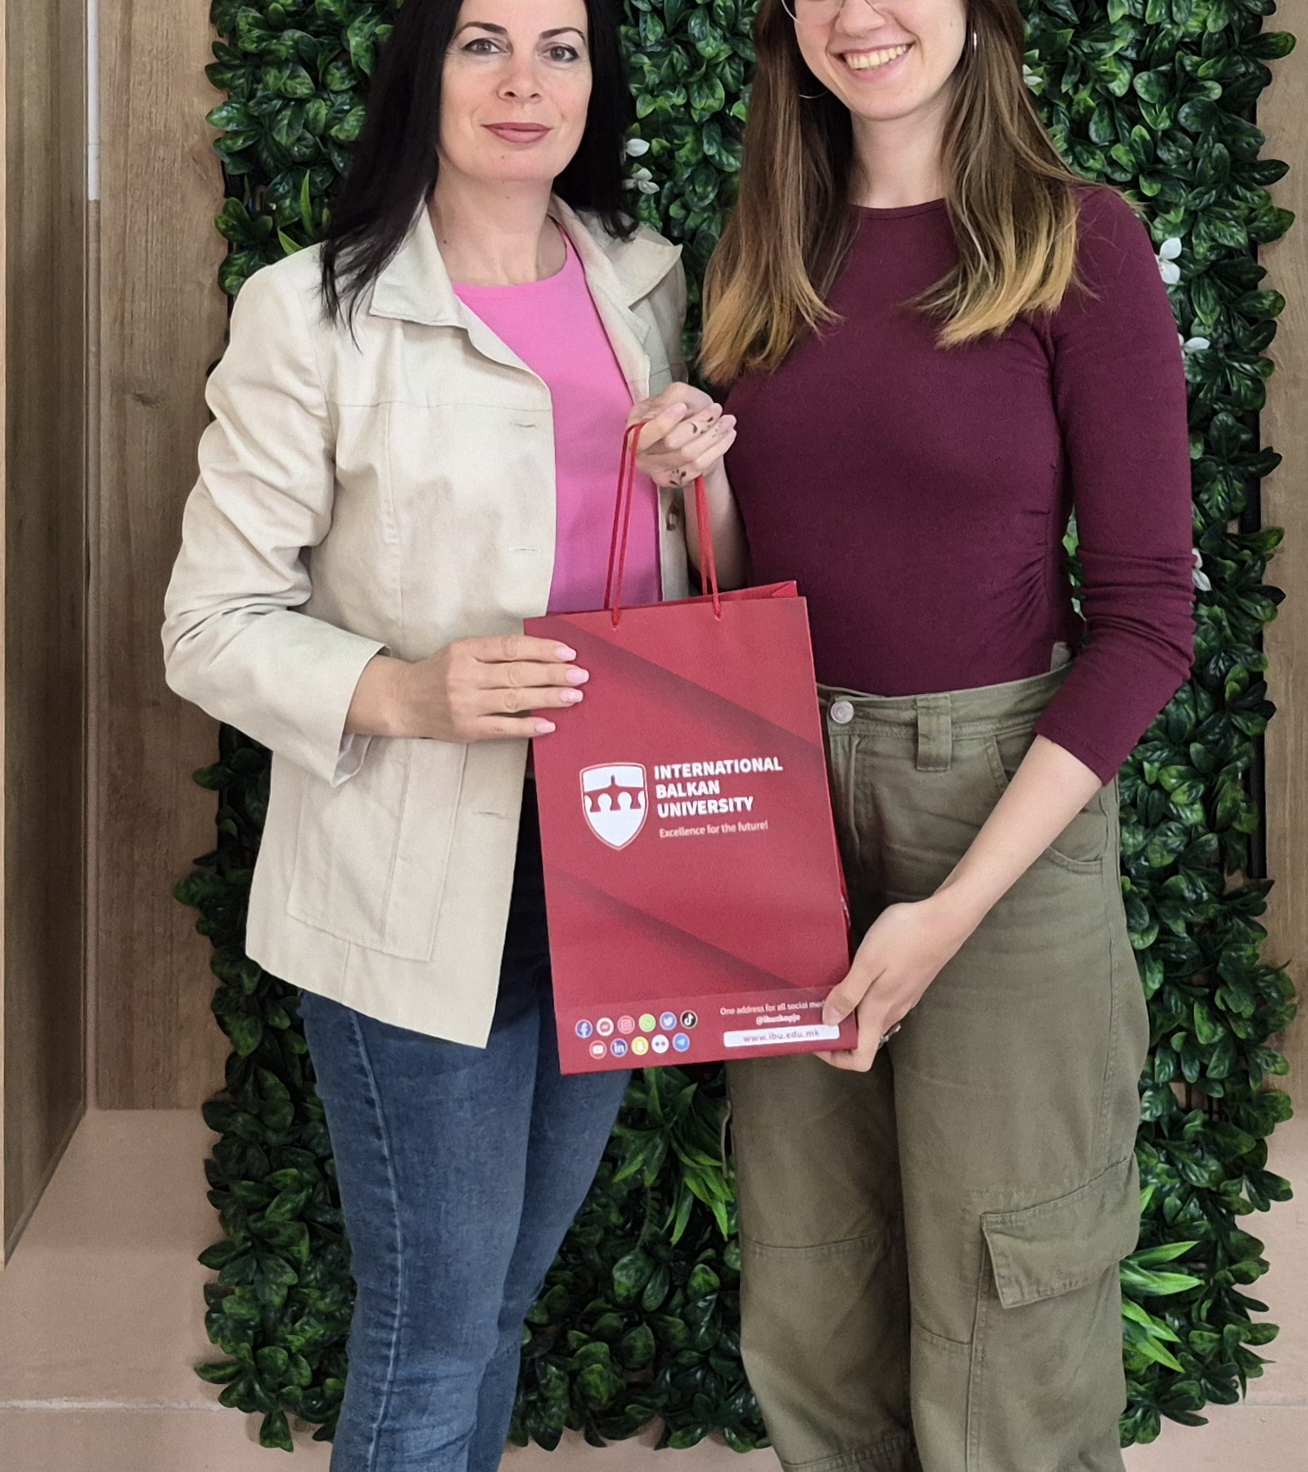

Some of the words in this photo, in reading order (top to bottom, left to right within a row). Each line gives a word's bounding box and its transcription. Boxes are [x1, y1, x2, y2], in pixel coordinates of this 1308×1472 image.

[654, 757, 783, 780] INTERNATIONAL
[655, 780, 720, 799] BALKAN
[657, 796, 754, 818] UNIVERSITY
[659, 826, 705, 838] Excellence
[707, 825, 720, 834] for
[721, 823, 736, 833] the
[737, 821, 768, 832] future!
[720, 1007, 735, 1015] One
[736, 1006, 765, 1014] address
[765, 1003, 776, 1012] for
[777, 1003, 786, 1011] all
[787, 1001, 808, 1010] social
[743, 1029, 820, 1042] www.ibu.edu.mk
